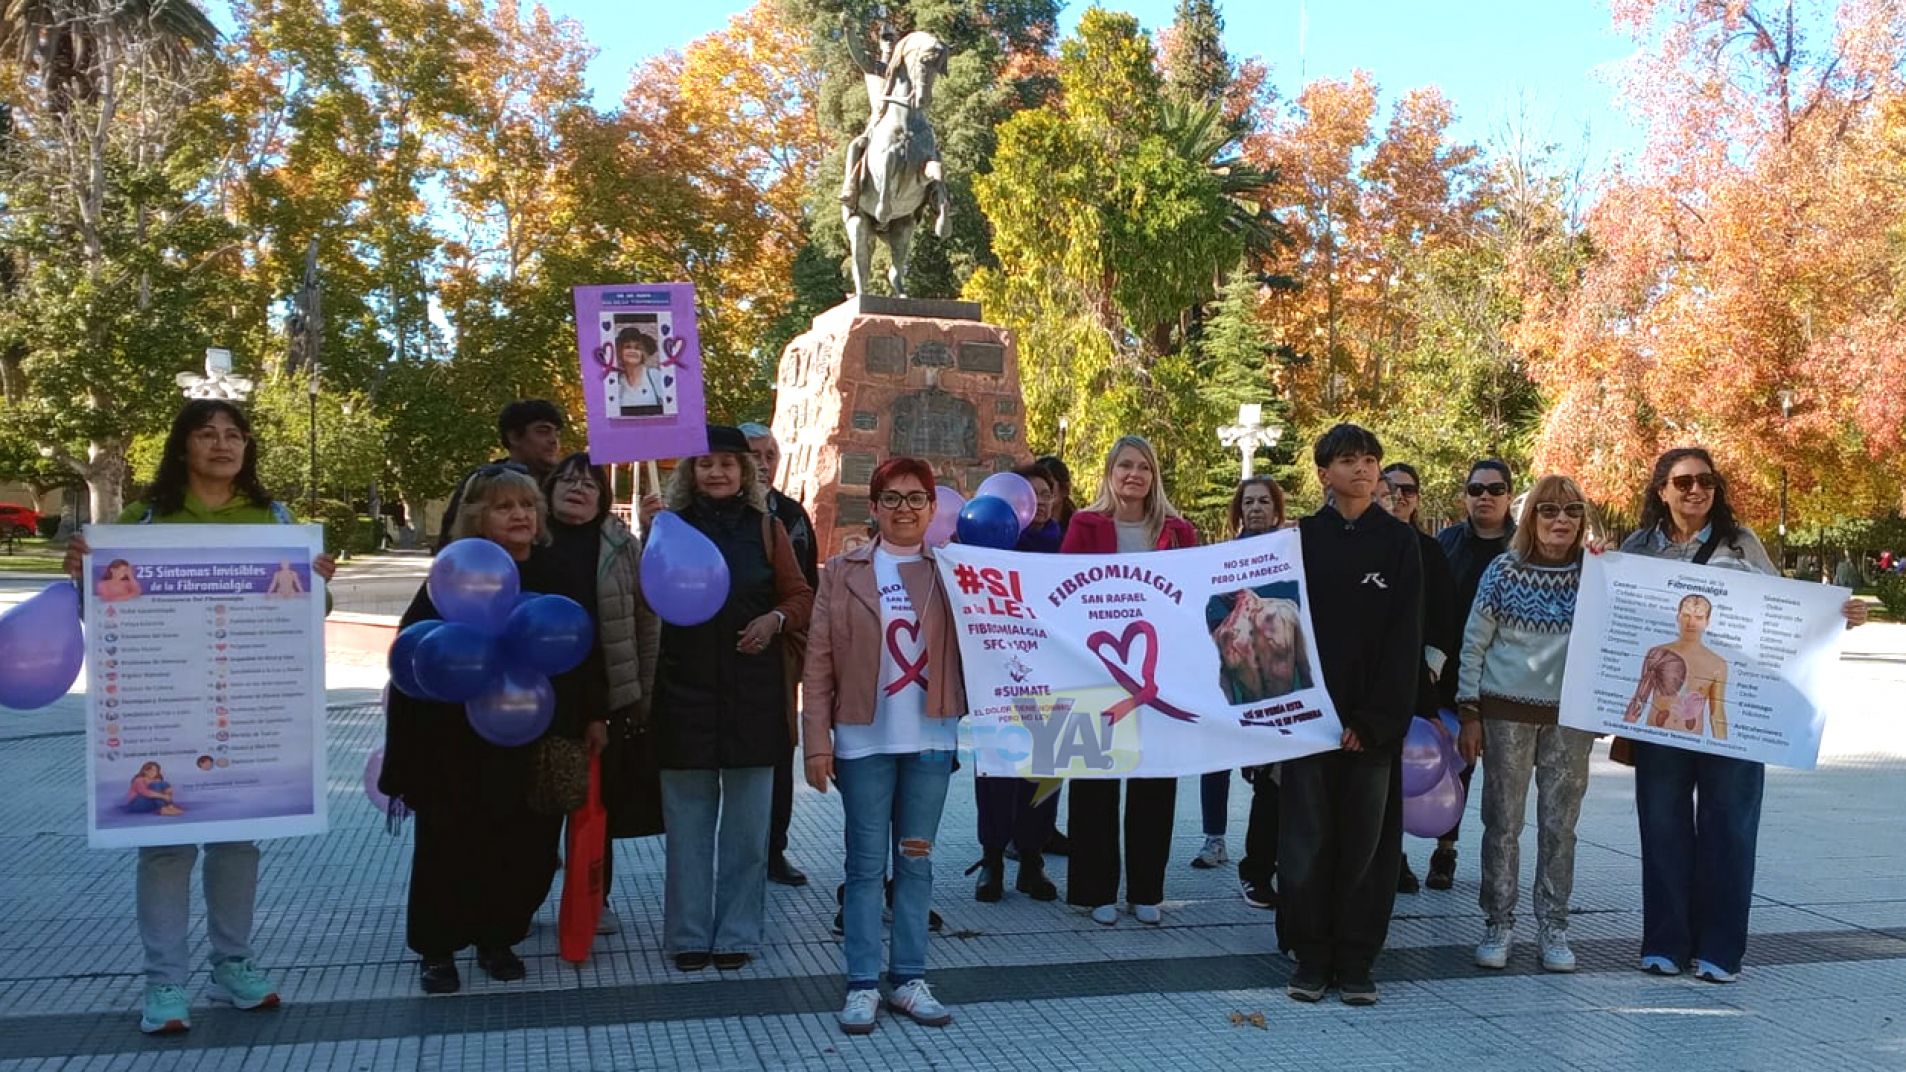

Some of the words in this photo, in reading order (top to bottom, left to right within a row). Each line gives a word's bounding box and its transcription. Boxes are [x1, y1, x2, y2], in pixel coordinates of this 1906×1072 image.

[1223, 560, 1238, 569] NO
[1239, 558, 1250, 567] SE
[136, 565, 153, 578] 25
[212, 564, 266, 577] Invisibles
[1211, 573, 1235, 584] PERO
[1236, 571, 1248, 580] LA
[150, 580, 162, 591] de
[164, 580, 174, 591] la
[176, 578, 253, 593] Fibromialgia
[953, 563, 1024, 603] #SI
[1047, 564, 1183, 608] FIBROMIALGIA
[1666, 578, 1729, 597] Fibromialgia
[1080, 594, 1104, 604] SAN
[1105, 592, 1147, 604] RAFAEL
[1088, 608, 1143, 620] MENDOZA
[983, 639, 1006, 650] SFC
[994, 685, 1052, 698] #SUMATE
[985, 705, 1010, 714] DOLOR
